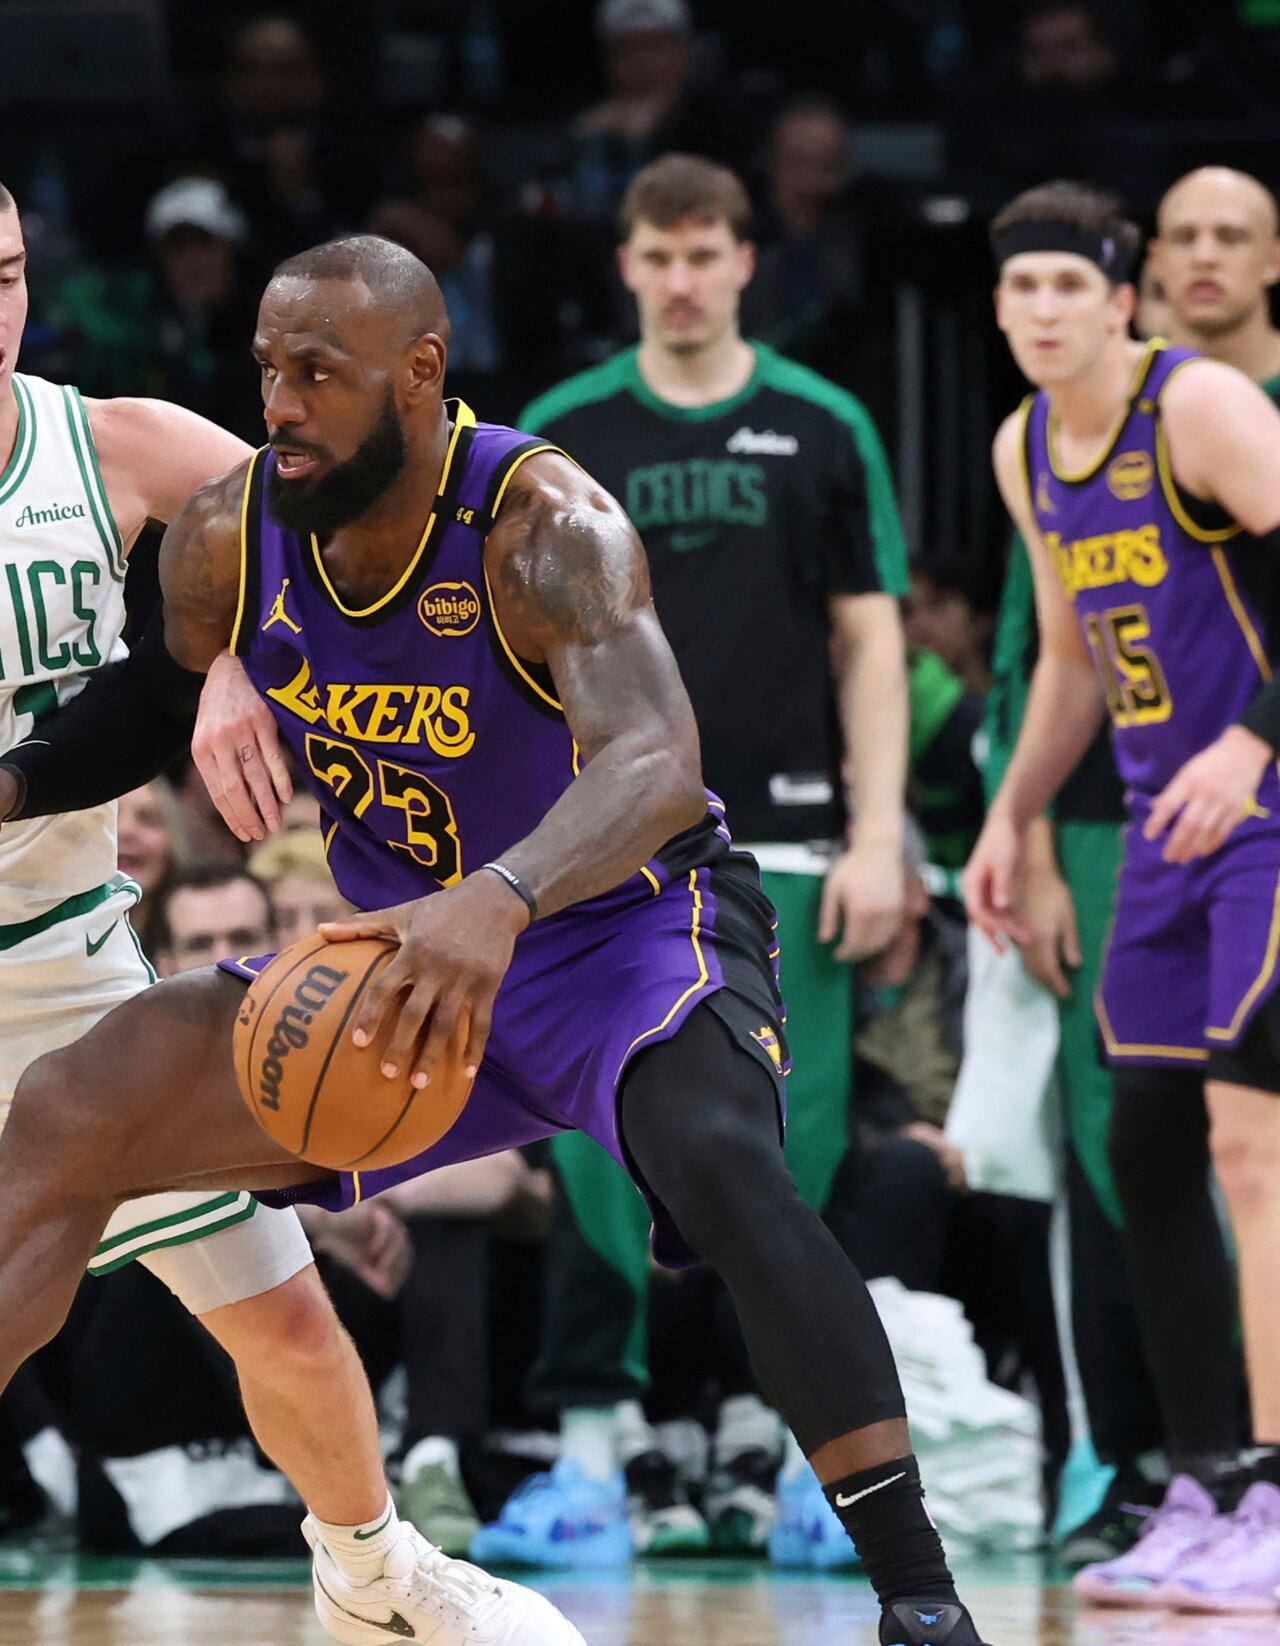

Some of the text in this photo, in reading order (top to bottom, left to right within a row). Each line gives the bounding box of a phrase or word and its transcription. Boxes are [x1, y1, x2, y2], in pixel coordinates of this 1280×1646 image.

[16, 503, 86, 528] Amica
[627, 458, 767, 528] CELTICS
[423, 596, 477, 620] bibigo
[1084, 603, 1173, 728] 15
[259, 964, 351, 1112] Wilson
